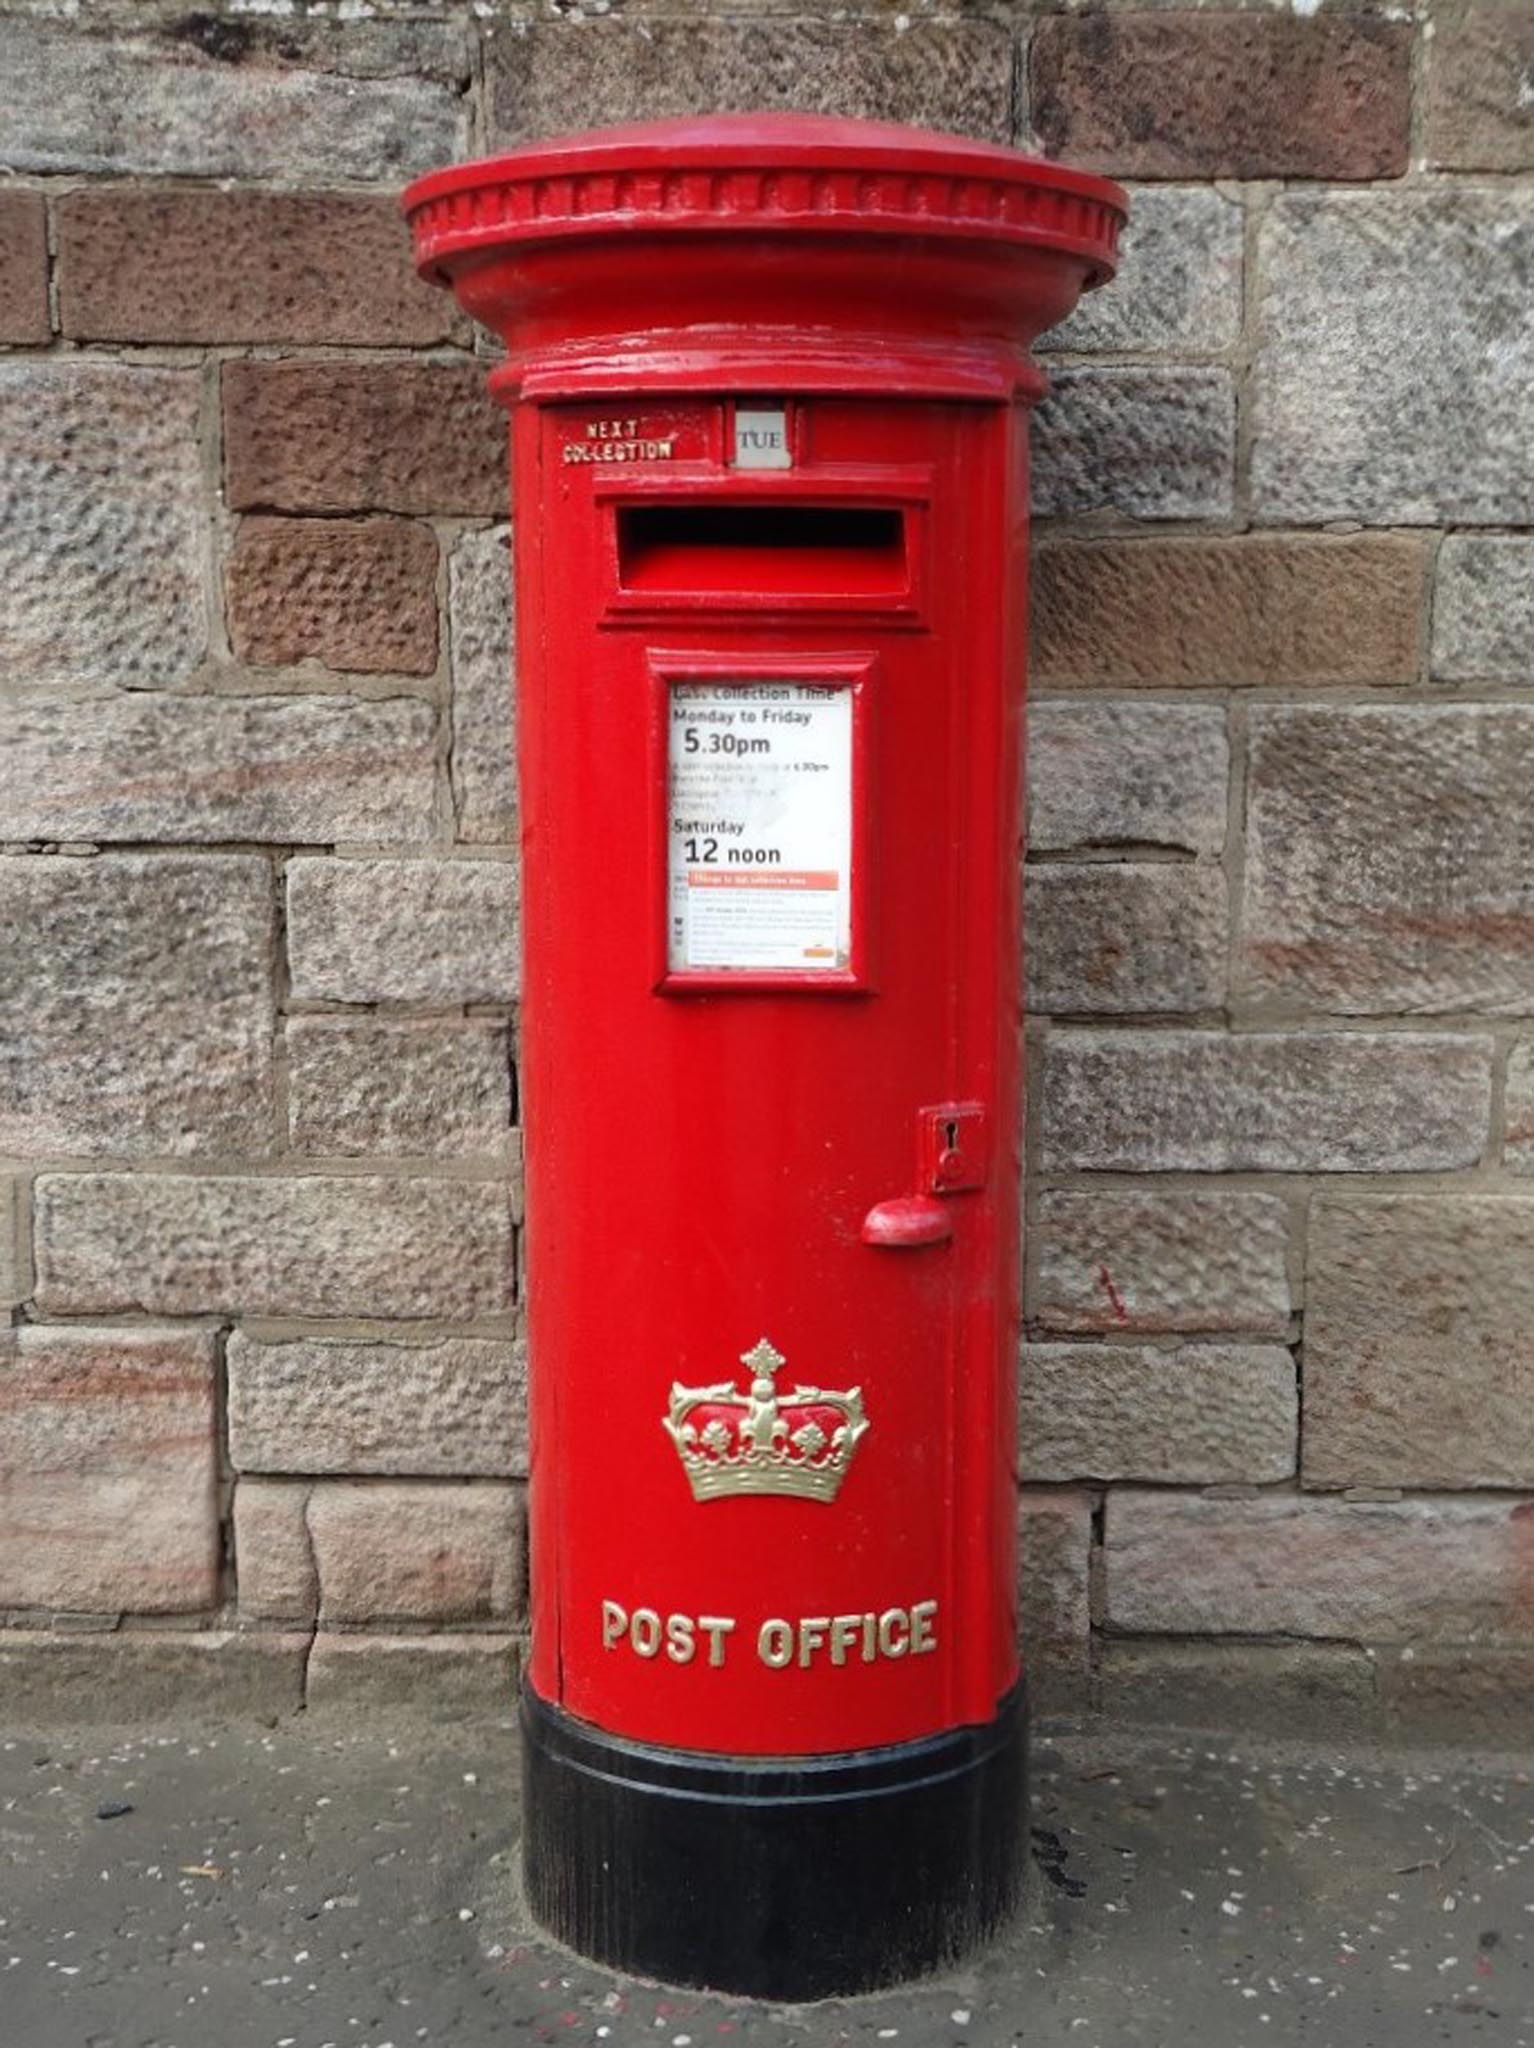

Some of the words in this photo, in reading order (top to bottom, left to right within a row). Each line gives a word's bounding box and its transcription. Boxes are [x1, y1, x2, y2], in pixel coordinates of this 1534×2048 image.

[587, 419, 637, 438] NEXT
[738, 431, 781, 449] TUE
[563, 440, 672, 463] COLLECTION
[673, 709, 735, 727] Monday
[740, 710, 756, 723] to
[762, 708, 812, 727] Friday
[684, 728, 770, 757] 5.30pm
[674, 818, 745, 836] Saturday
[684, 838, 718, 863] 12
[728, 847, 781, 863] noon
[602, 1600, 735, 1668] POST
[758, 1600, 938, 1669] OFFICE
